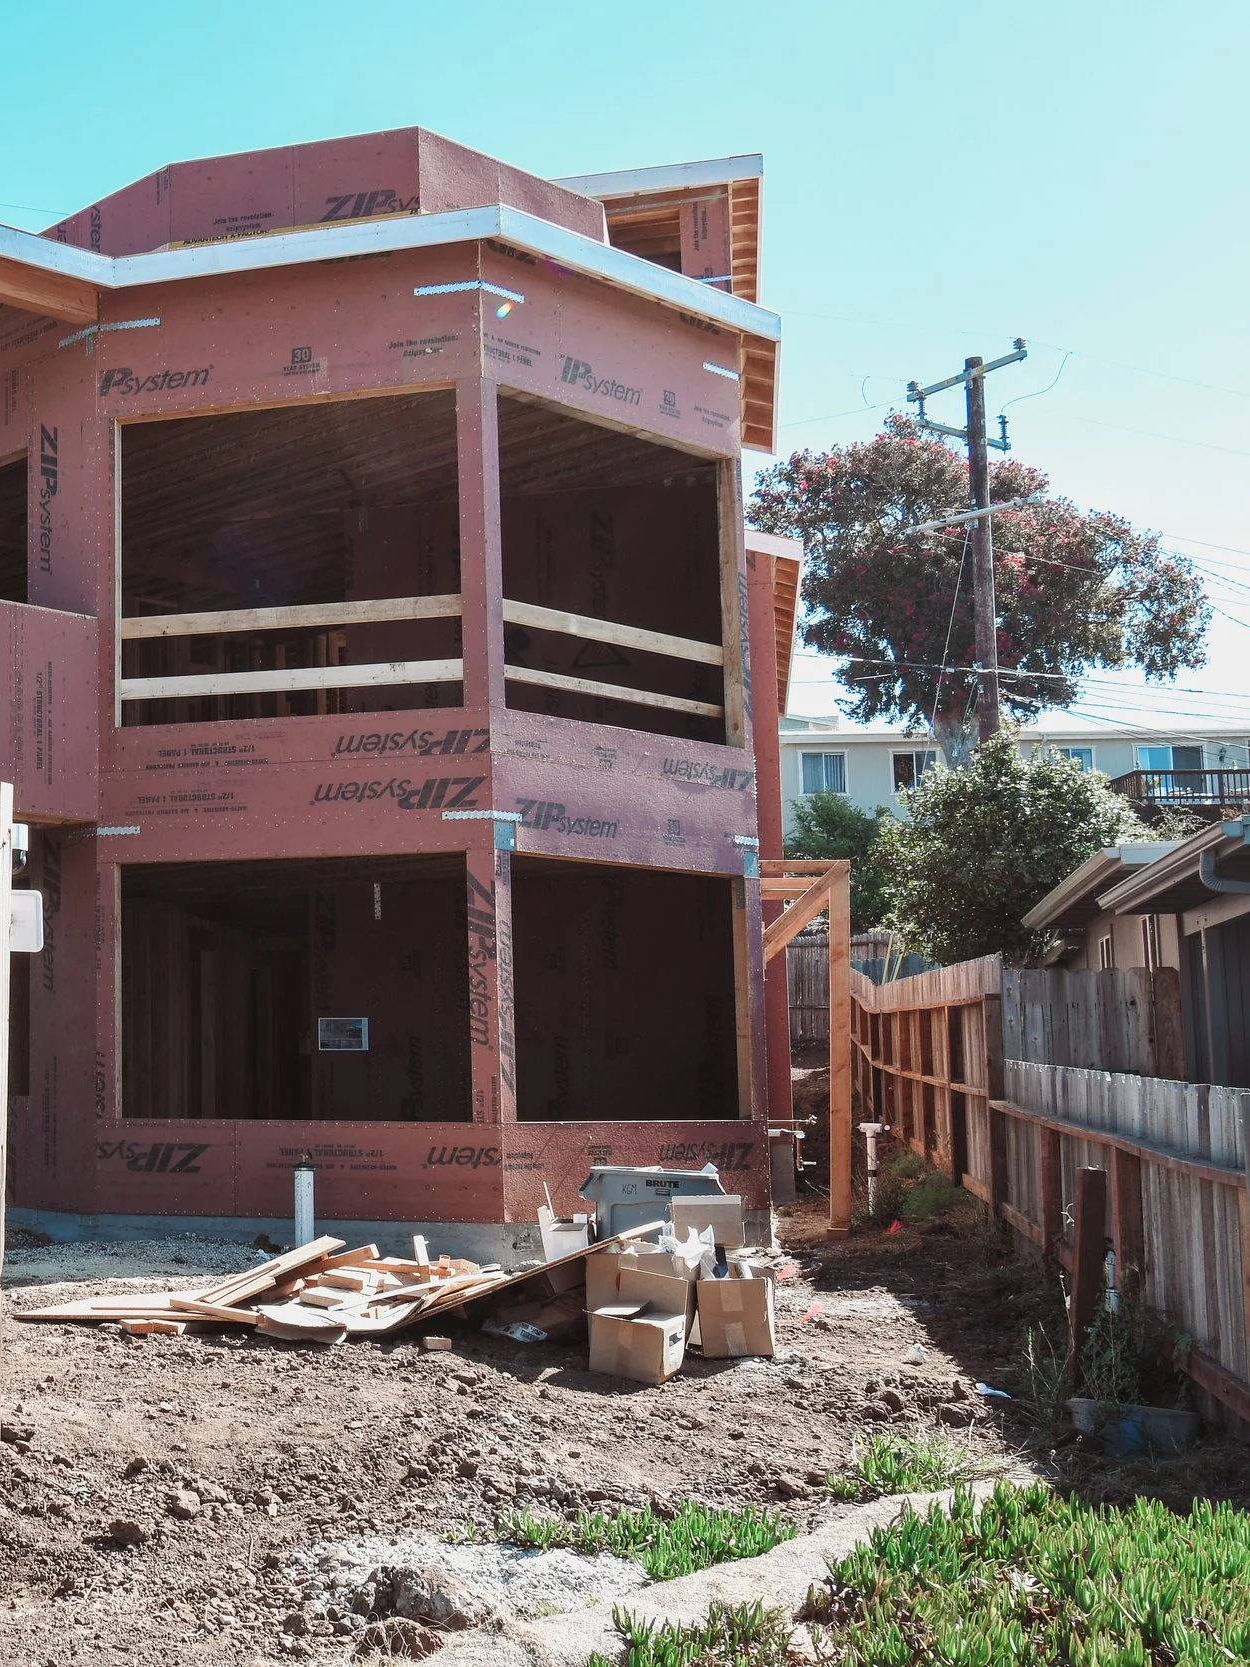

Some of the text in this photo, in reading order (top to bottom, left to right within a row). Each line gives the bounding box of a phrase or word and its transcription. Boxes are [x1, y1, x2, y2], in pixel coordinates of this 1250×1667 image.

[40, 424, 58, 572] ZIPsystem
[158, 749, 181, 758] PANEL
[190, 745, 237, 756] STRUCTURAL
[169, 793, 216, 802] STRUCTURAL
[314, 776, 488, 810] ZIPsystem
[137, 796, 160, 804] PANEL
[467, 870, 497, 1046] ZIPsystem
[646, 1179, 680, 1188] BRUTE
[622, 1184, 637, 1195] KGM
